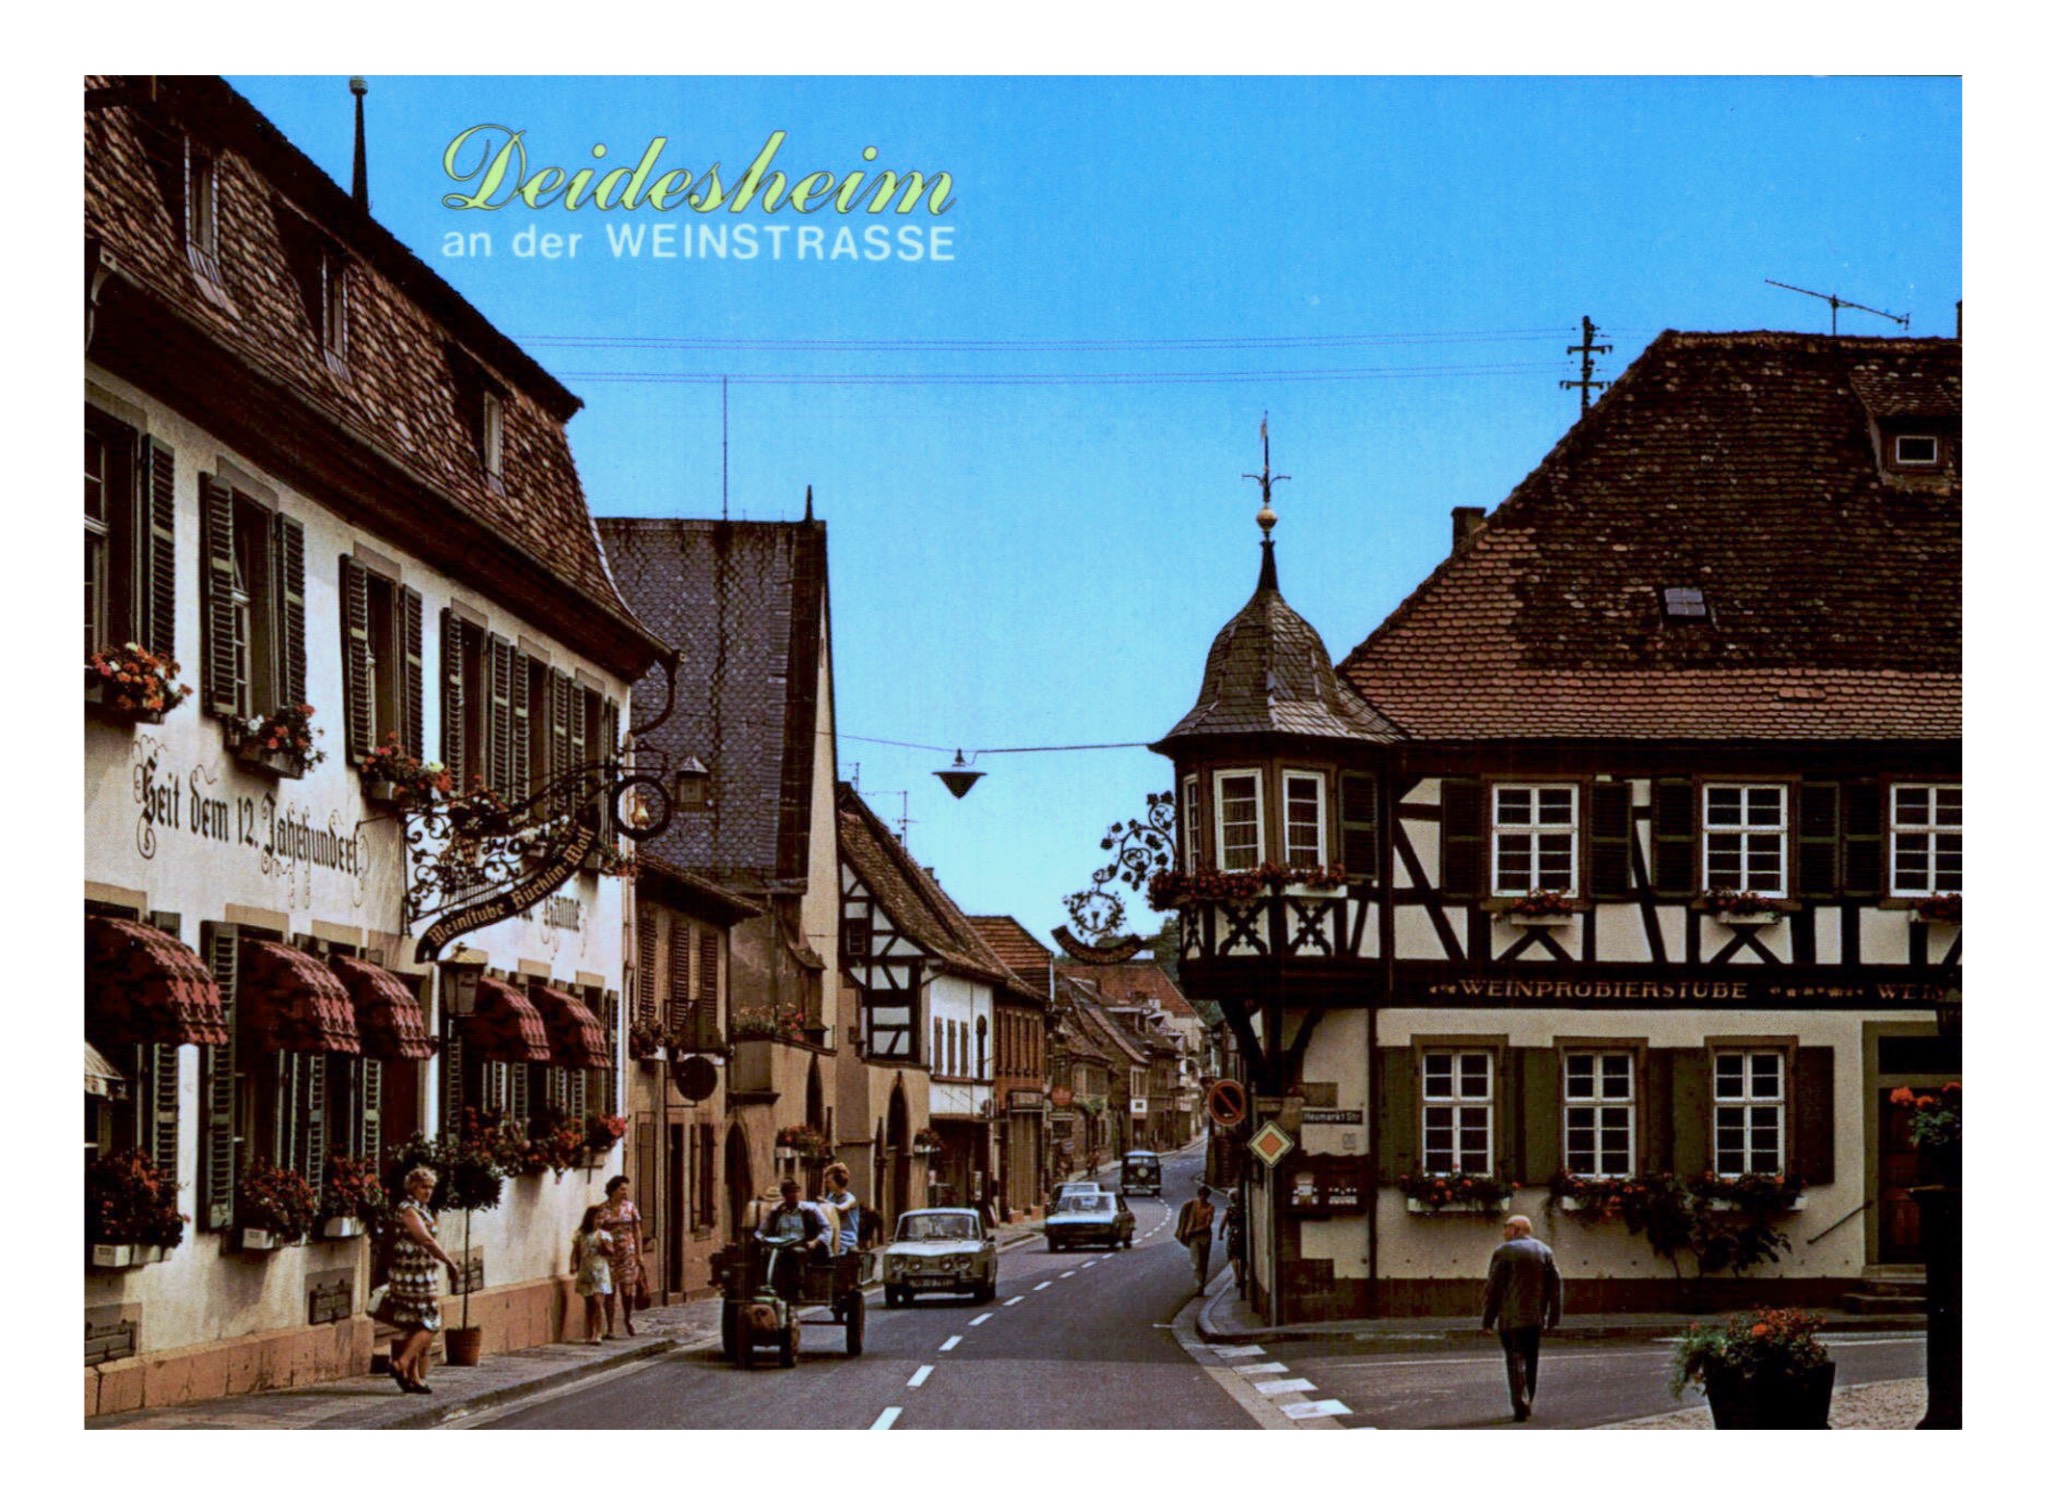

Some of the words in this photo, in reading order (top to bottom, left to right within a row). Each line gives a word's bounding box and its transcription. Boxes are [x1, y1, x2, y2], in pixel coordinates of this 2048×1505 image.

[133, 745, 180, 850] Seit
[190, 765, 229, 842] dem
[238, 796, 259, 849] 12.
[261, 792, 370, 885] Jahrhundert
[1458, 979, 1748, 999] WEINPROBIERSTUBE
